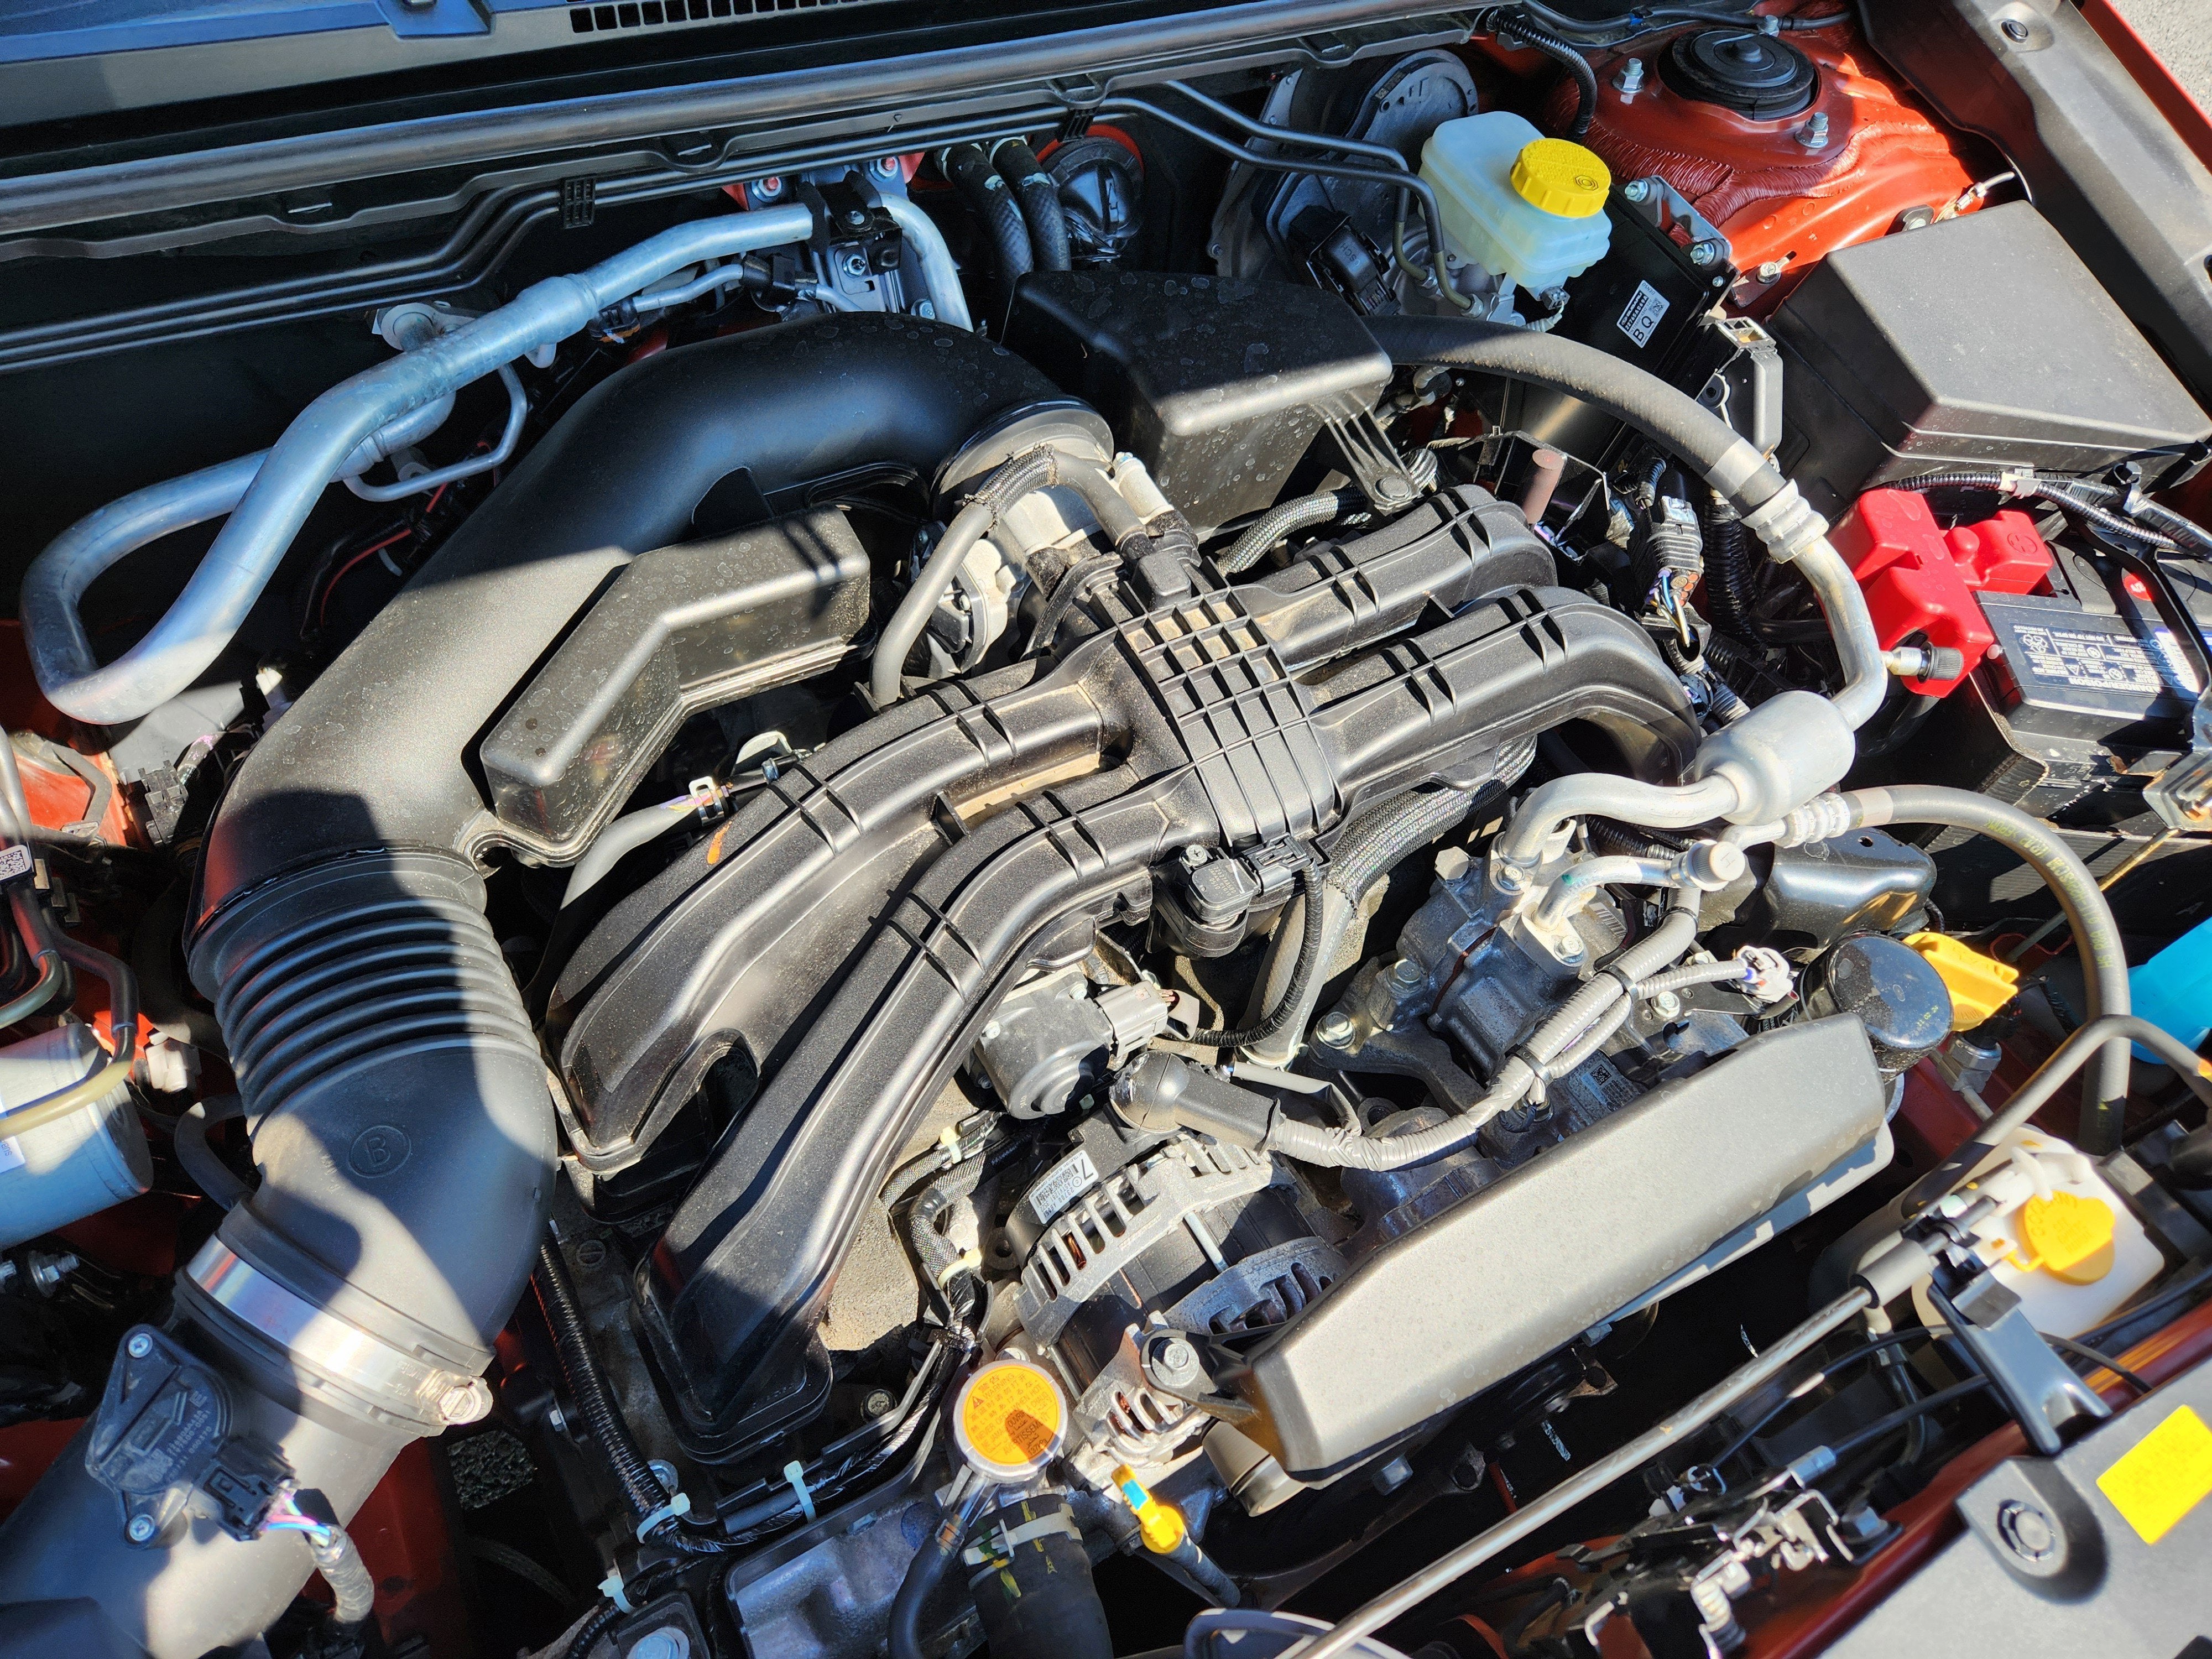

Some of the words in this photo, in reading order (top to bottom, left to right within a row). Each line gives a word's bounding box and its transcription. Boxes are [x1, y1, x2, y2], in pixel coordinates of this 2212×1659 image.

[1626, 291, 1642, 317] SUBARU
[1631, 327, 1646, 342] B
[1639, 315, 1655, 330] Q
[1073, 1158, 1094, 1181] 7
[1057, 1186, 1074, 1203] 23700
[982, 1371, 1015, 1400] WARNING
[1001, 1412, 1051, 1455] AVERTISSEMENT
